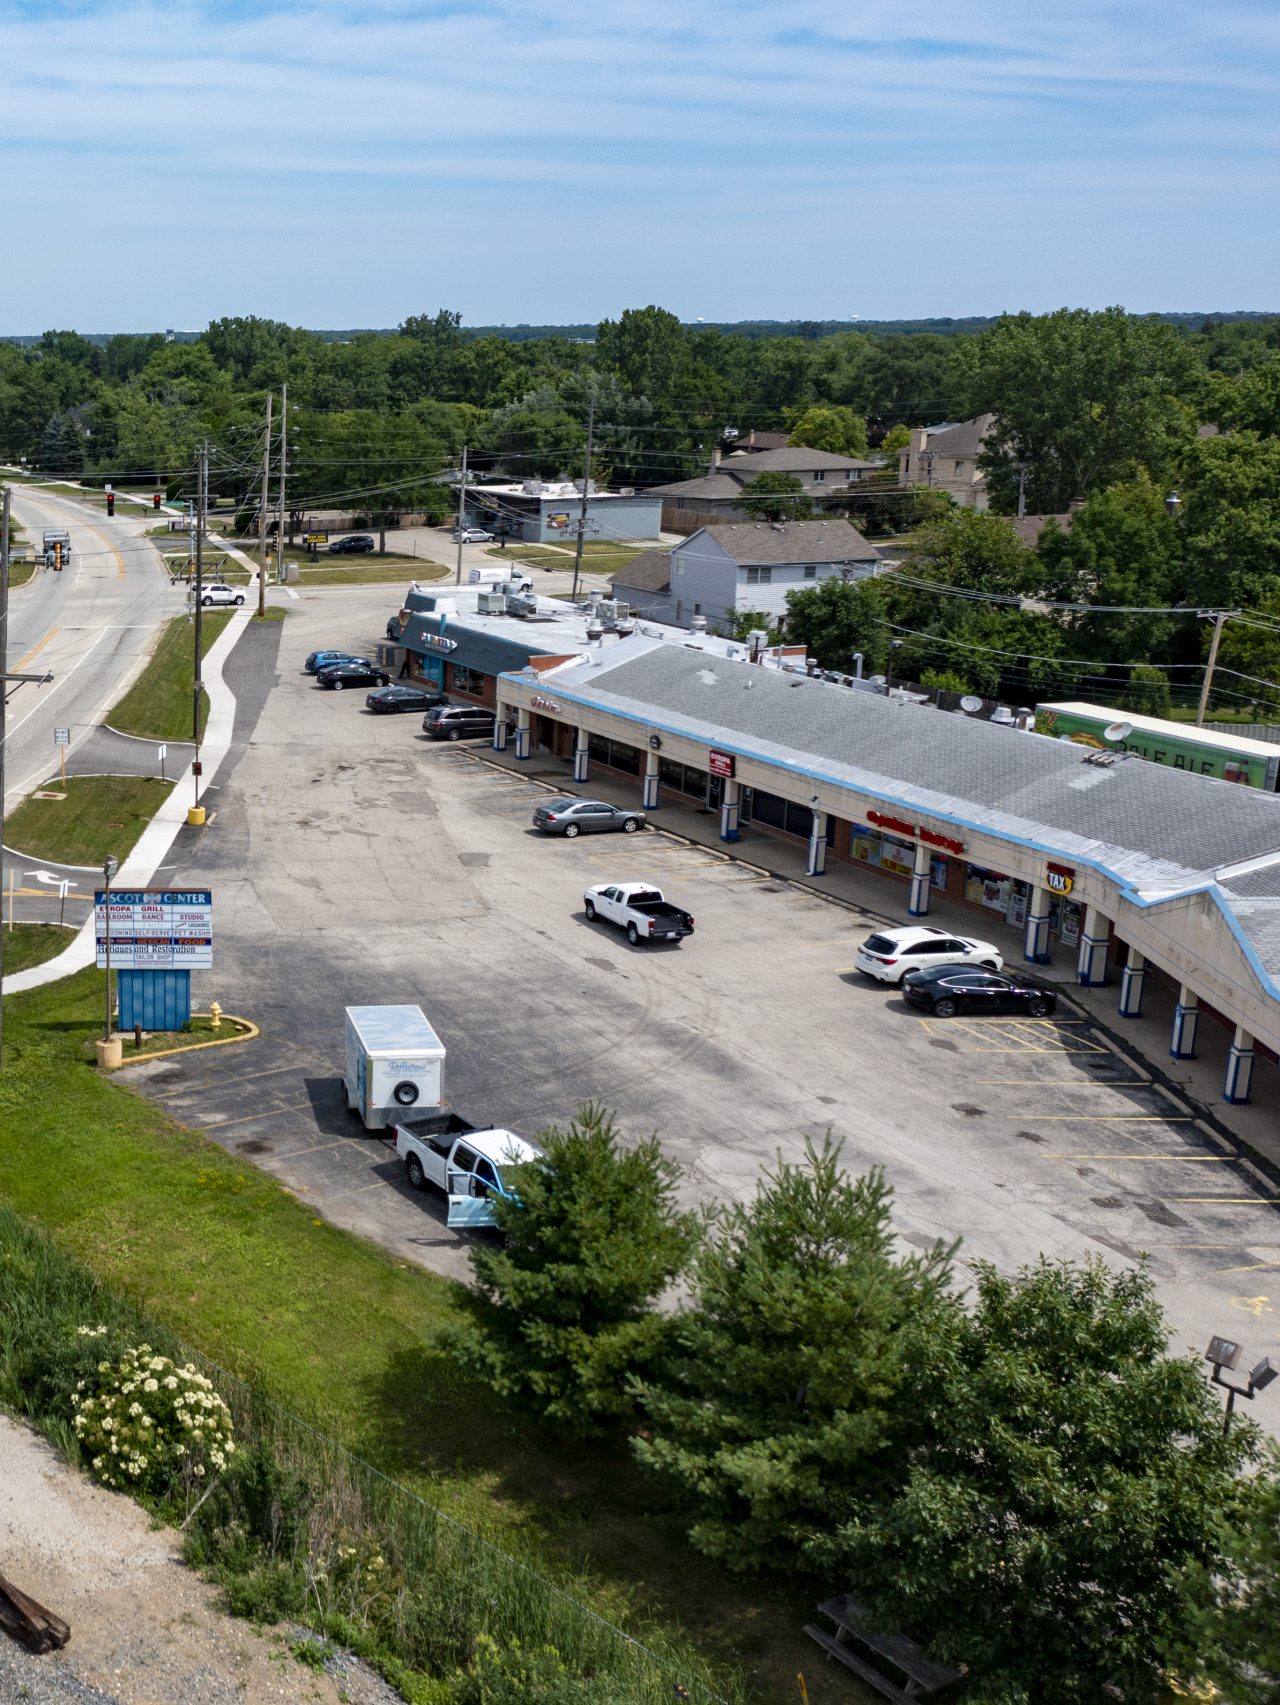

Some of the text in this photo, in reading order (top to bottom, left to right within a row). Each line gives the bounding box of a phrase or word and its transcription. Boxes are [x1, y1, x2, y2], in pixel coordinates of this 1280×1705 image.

[1049, 872, 1065, 890] TAX
[100, 893, 206, 903] ASCOT CENTER
[133, 945, 149, 954] and
[152, 945, 196, 954] Restoration
